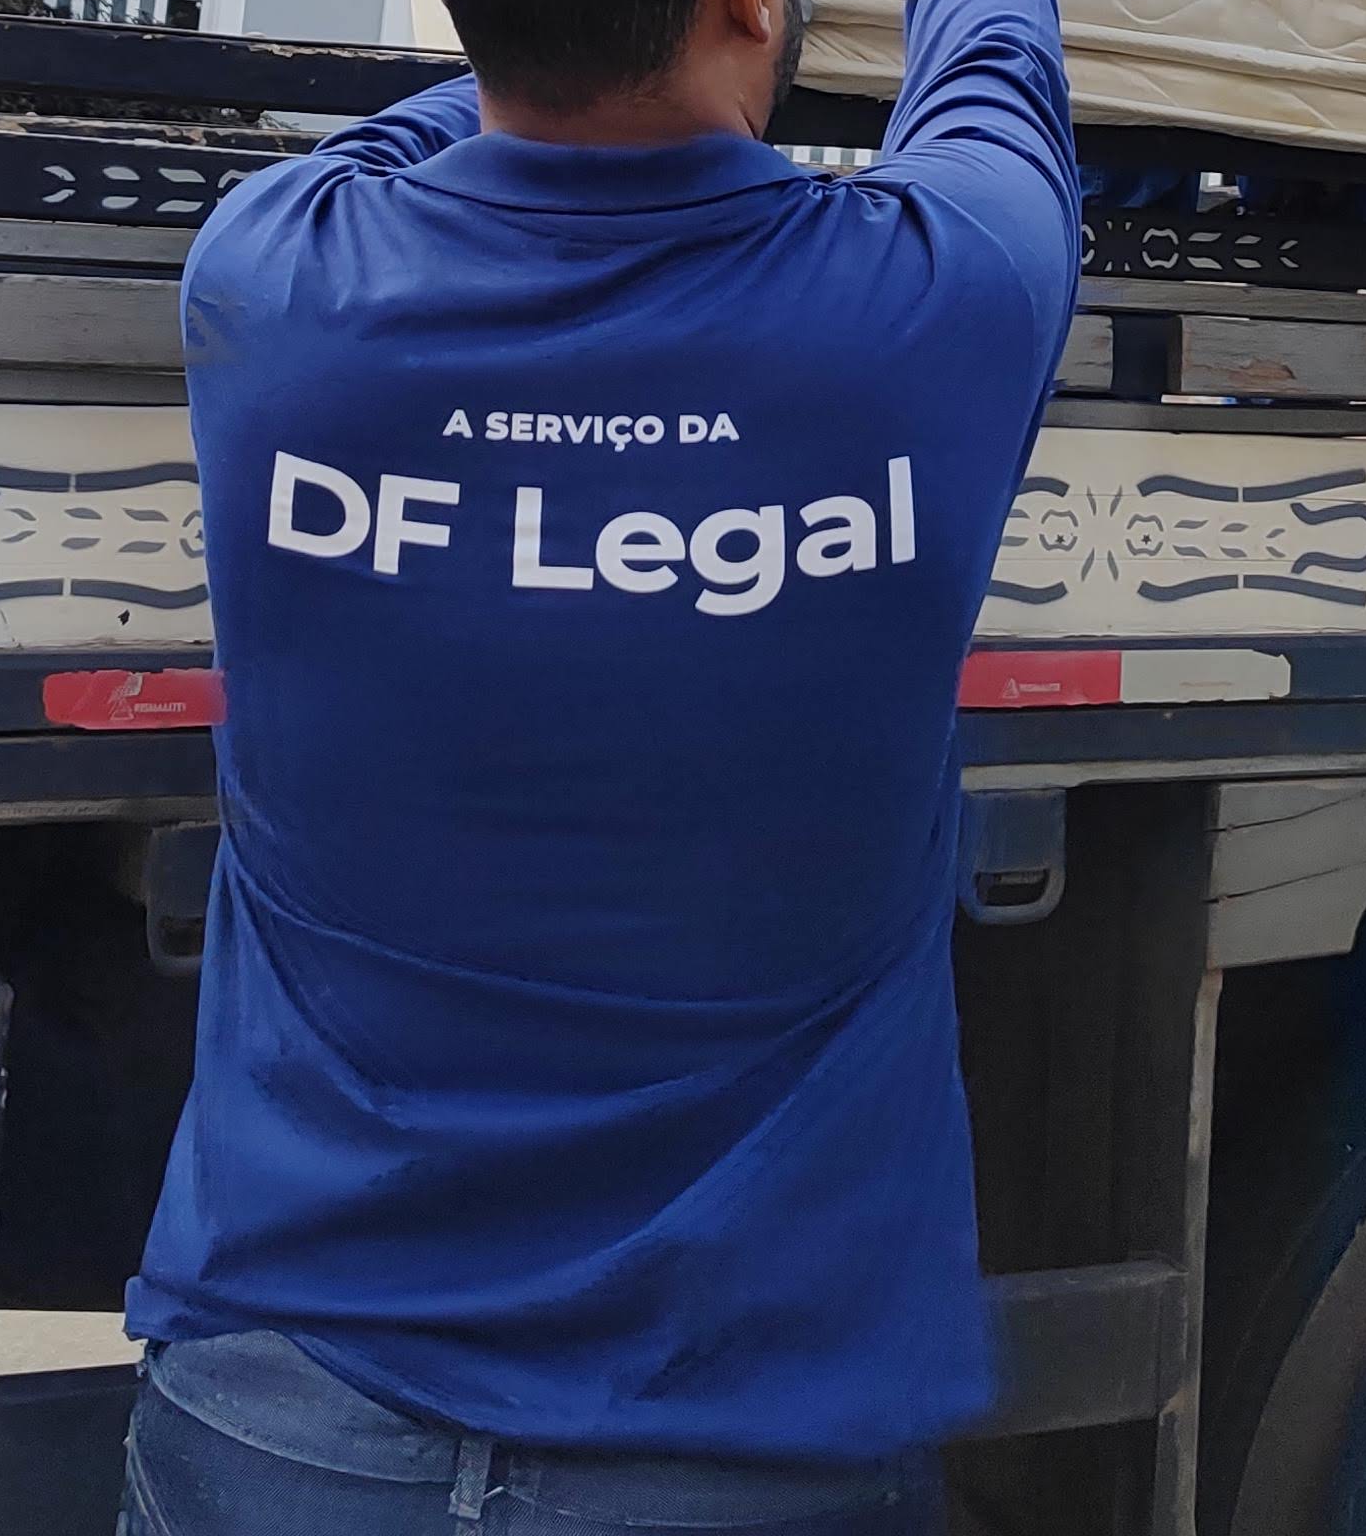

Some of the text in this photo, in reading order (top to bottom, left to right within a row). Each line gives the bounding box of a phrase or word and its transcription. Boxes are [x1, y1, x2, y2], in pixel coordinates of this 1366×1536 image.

[443, 409, 740, 451] A SERVIÇO DA
[267, 450, 916, 616] DF Legal
